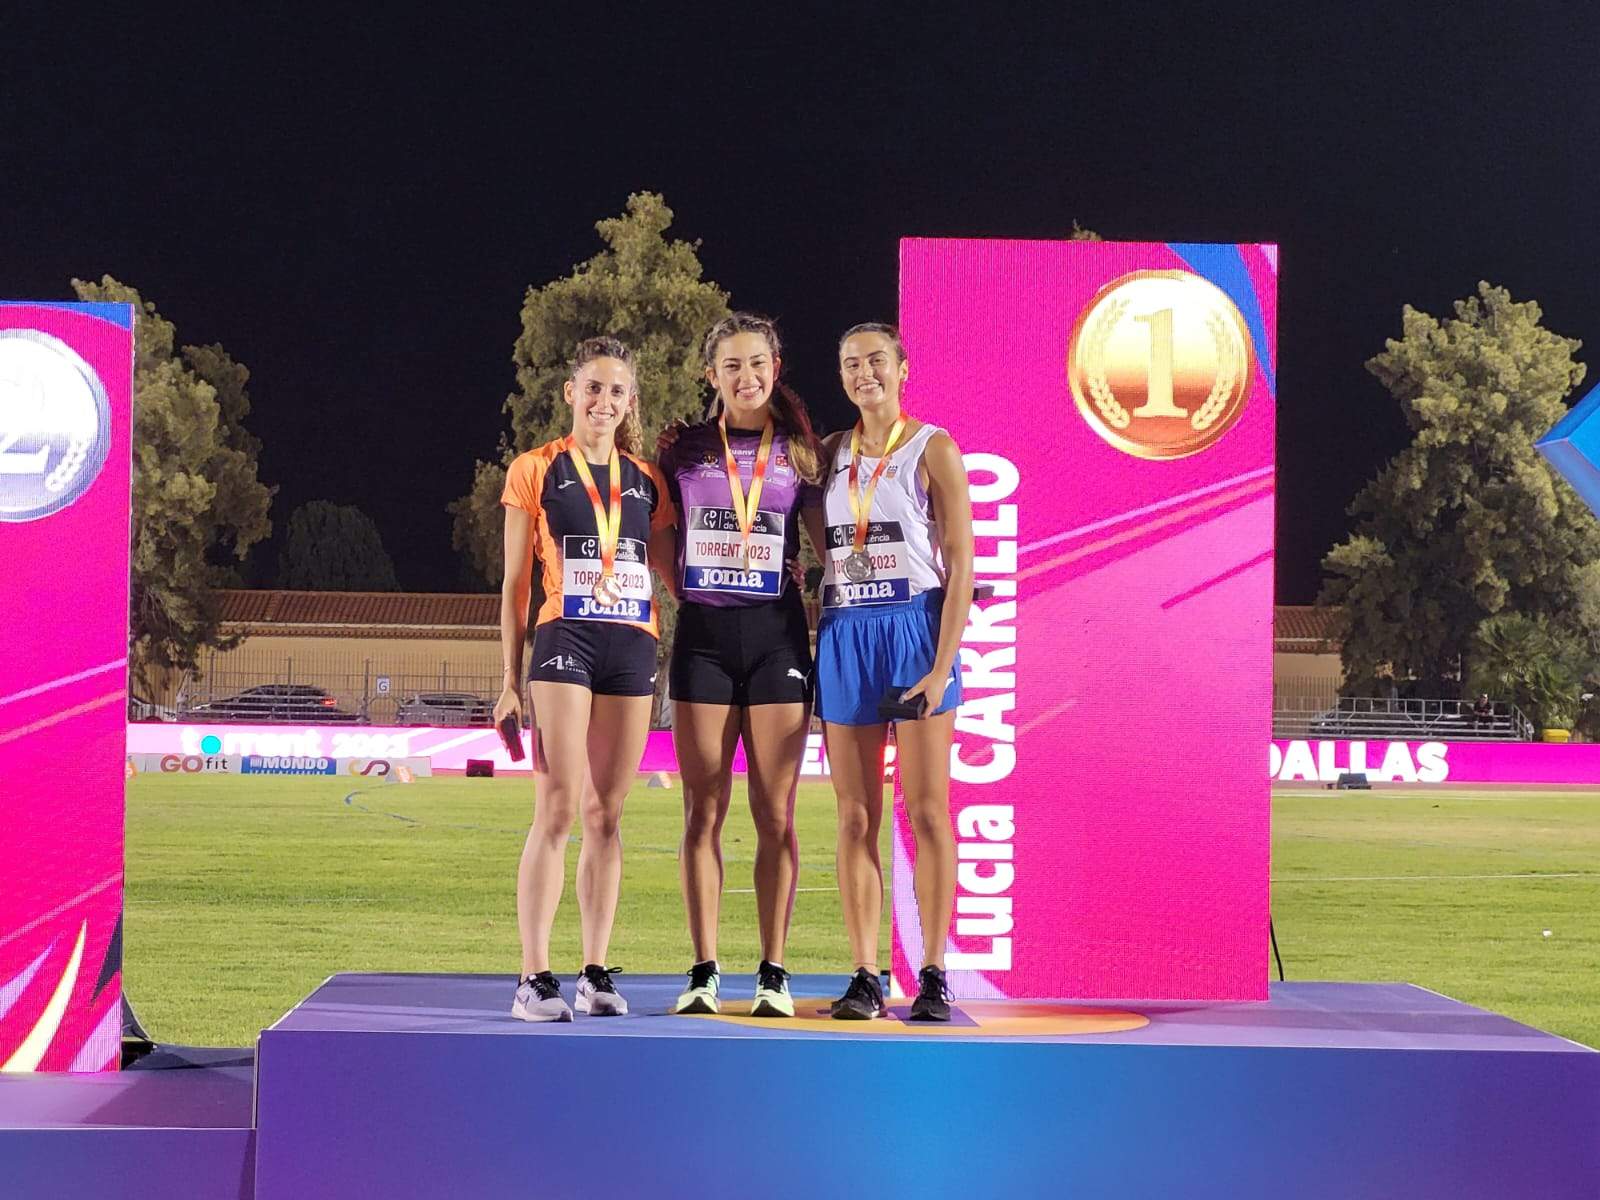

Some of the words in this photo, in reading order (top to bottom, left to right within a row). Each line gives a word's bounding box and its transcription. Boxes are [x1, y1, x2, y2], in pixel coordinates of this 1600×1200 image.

[1133, 308, 1188, 418] 1
[735, 523, 768, 533] Vncia
[695, 541, 741, 558] TORRENT
[743, 544, 771, 560] 023
[871, 554, 897, 570] 2023
[574, 570, 620, 586] TORRT
[622, 573, 644, 589] 2023
[262, 757, 328, 771] MONDO
